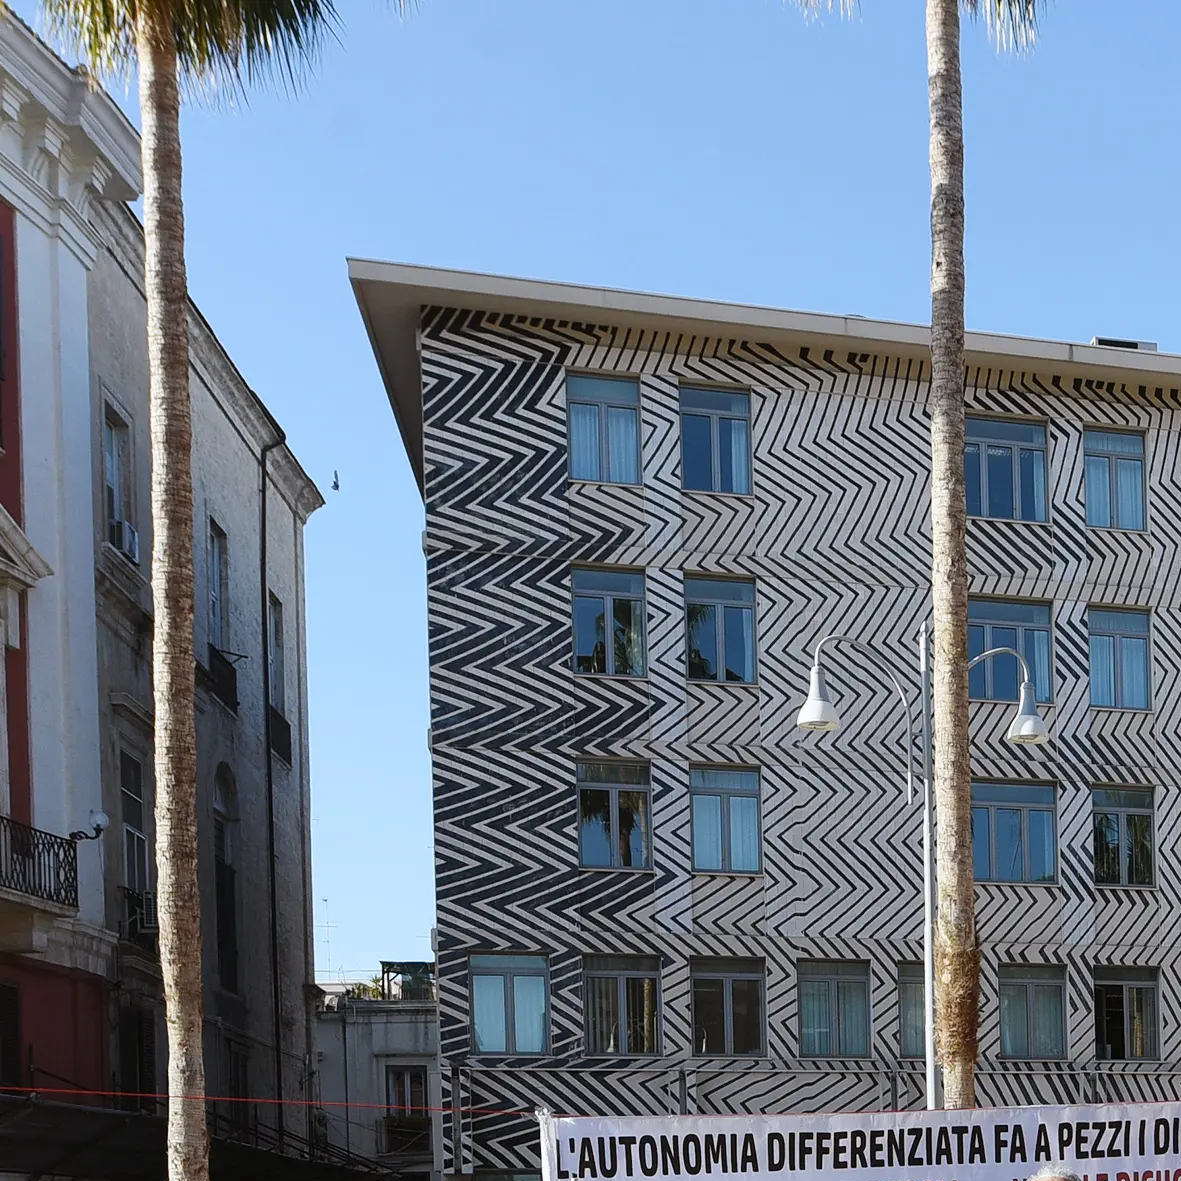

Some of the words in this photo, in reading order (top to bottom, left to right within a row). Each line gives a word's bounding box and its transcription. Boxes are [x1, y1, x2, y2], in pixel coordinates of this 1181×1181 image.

[556, 1133, 758, 1180] L'AUTONOMIA
[767, 1124, 987, 1173] DIFFERENZIATA
[994, 1123, 1028, 1164] FA
[1034, 1122, 1052, 1162] A
[1058, 1119, 1131, 1161] PEZZI
[1137, 1118, 1146, 1157] I
